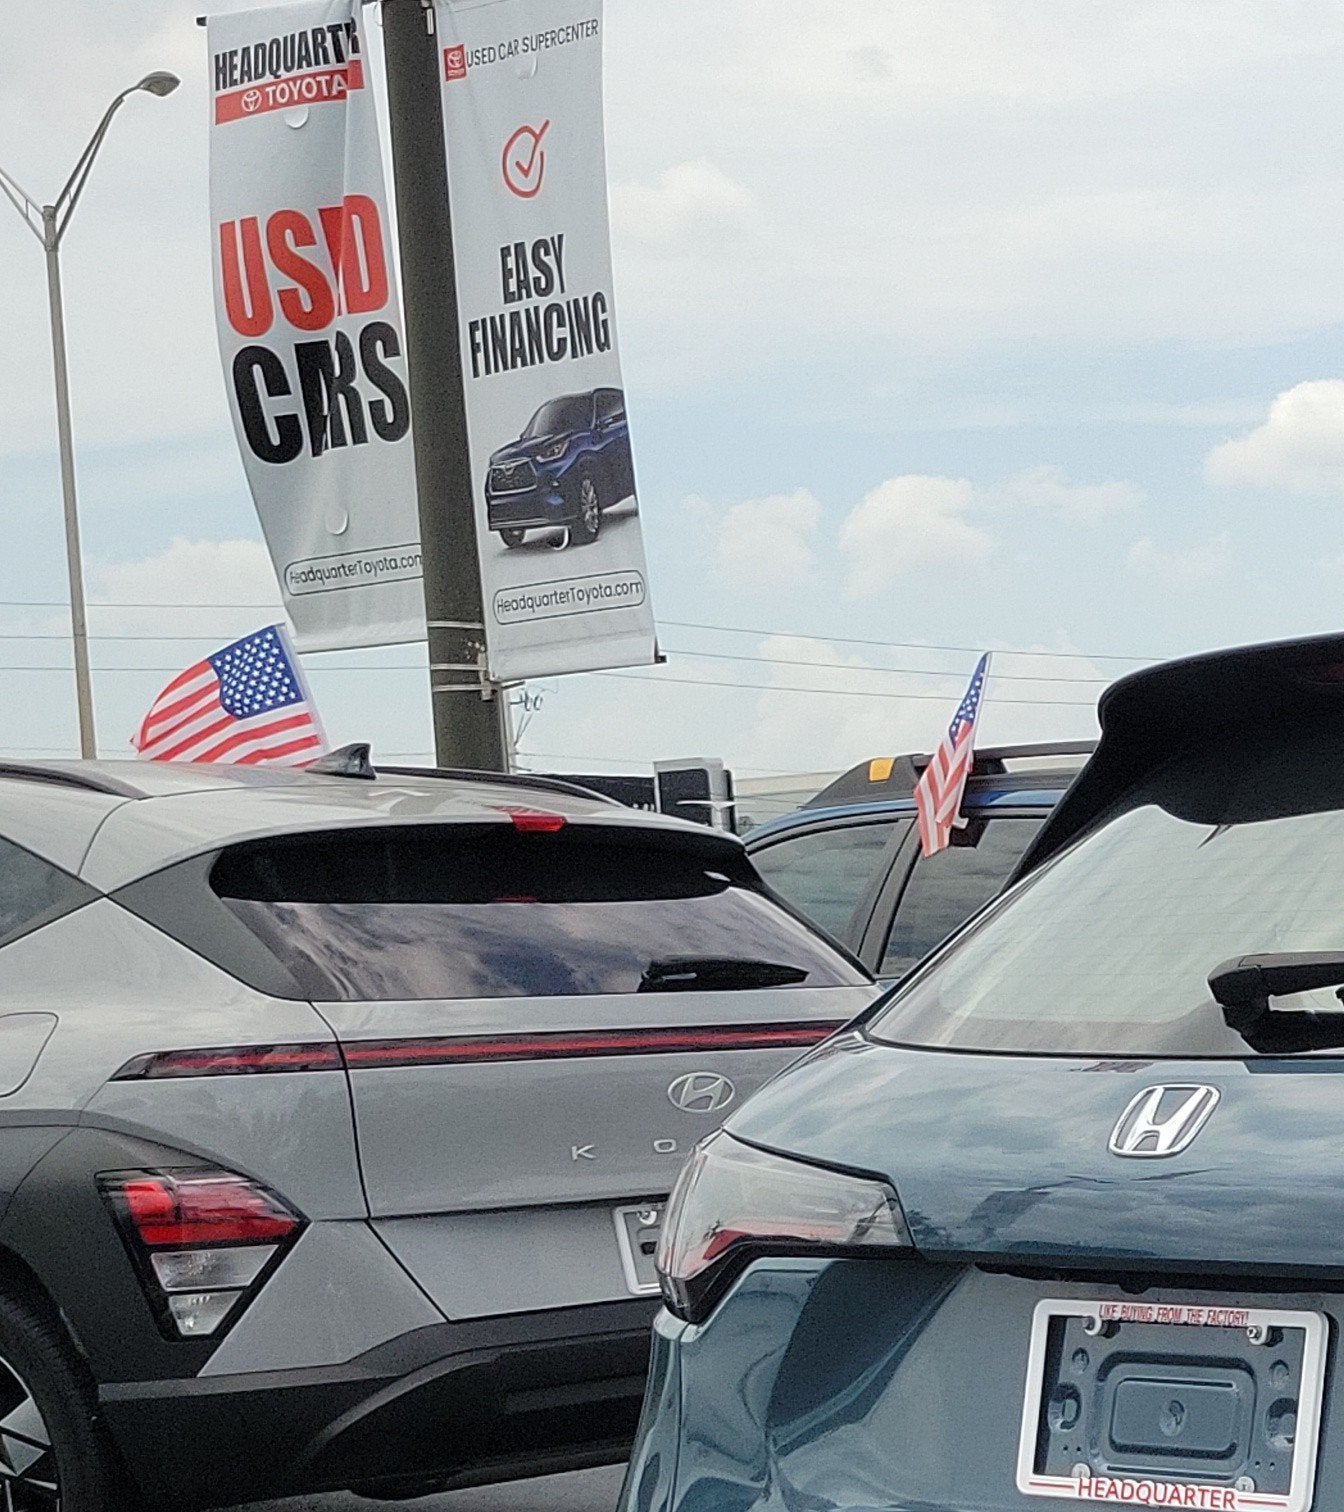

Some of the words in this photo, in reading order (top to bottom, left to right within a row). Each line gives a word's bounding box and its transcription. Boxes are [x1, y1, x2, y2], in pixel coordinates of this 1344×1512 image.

[214, 17, 361, 92] HEADQUARTR
[466, 46, 496, 68] USED
[498, 39, 519, 60] CAR
[521, 18, 599, 53] SUPERCENTER
[265, 74, 349, 106] TOYOTA
[499, 233, 566, 304] EASY
[468, 291, 611, 379] FINANCING
[1156, 1307, 1182, 1322] FROM
[1187, 1308, 1204, 1323] THE
[1077, 1477, 1237, 1510] HEADQUARTER
